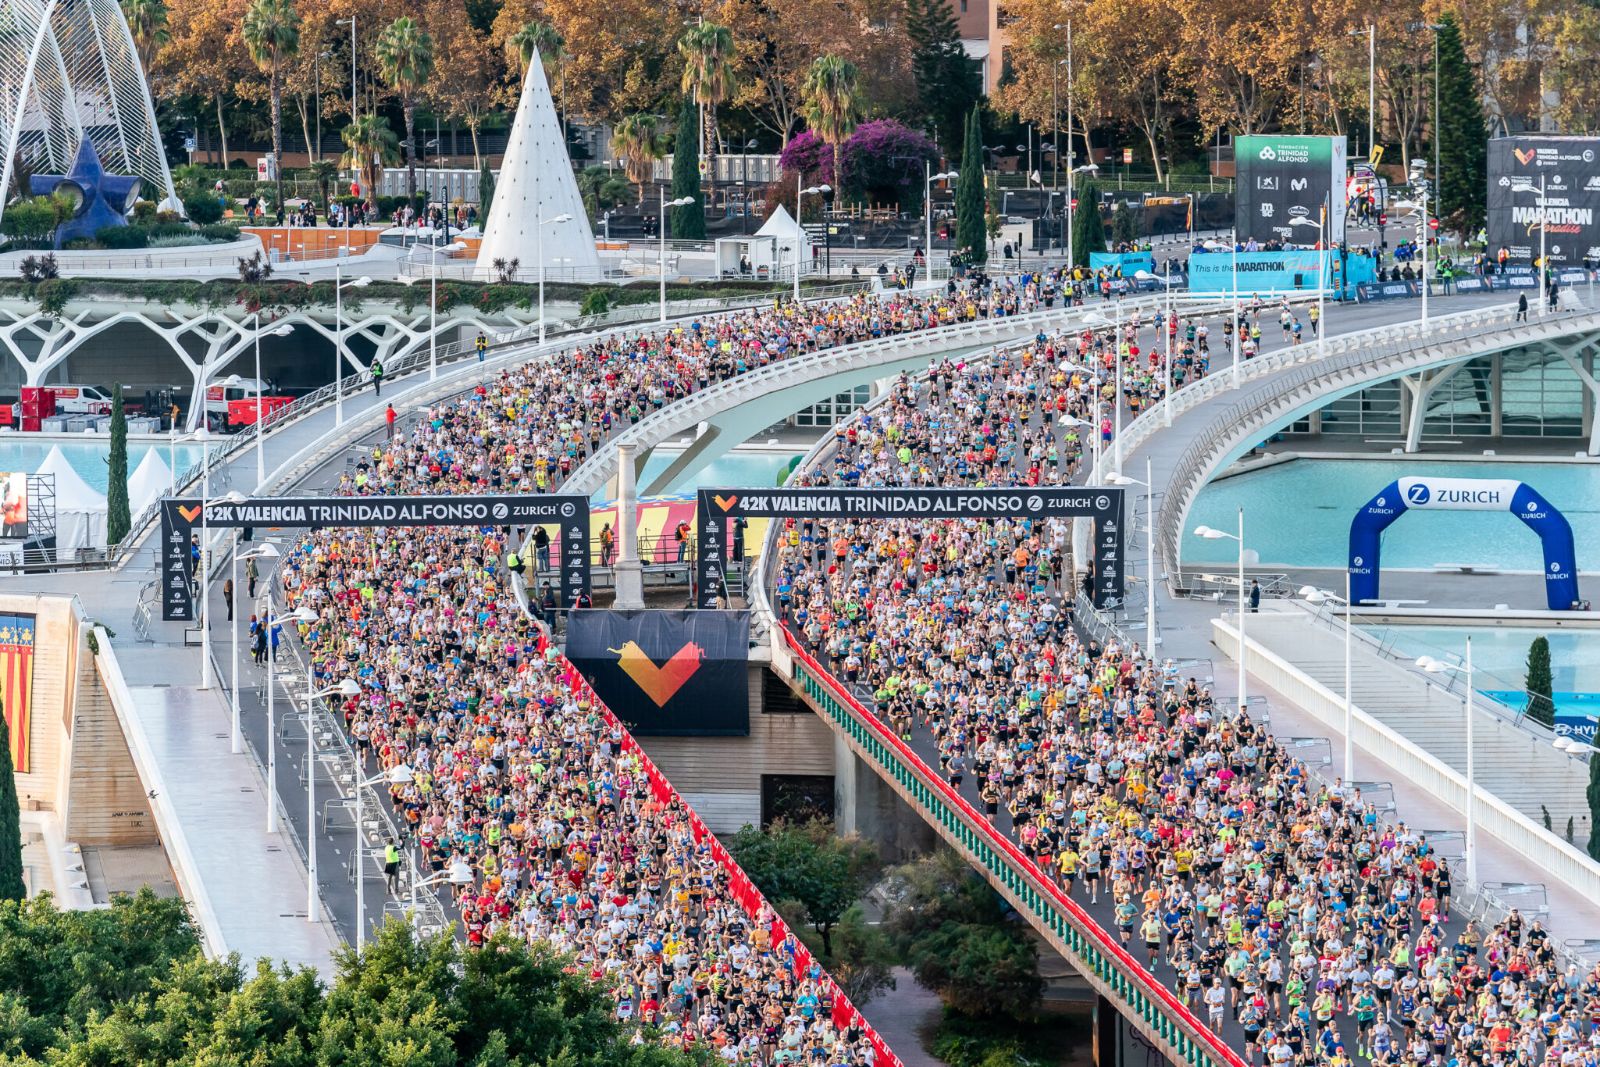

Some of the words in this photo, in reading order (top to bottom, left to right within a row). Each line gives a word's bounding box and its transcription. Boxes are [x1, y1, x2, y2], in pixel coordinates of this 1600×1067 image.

[1512, 206, 1592, 225] MARATHON
[1195, 264, 1211, 272] This
[1212, 264, 1220, 272] is
[1221, 263, 1233, 272] the
[1235, 261, 1285, 272] MARATHON
[738, 496, 769, 511] 42K
[771, 495, 841, 512] VALENCIA
[845, 496, 932, 512] TRINIDAD
[934, 495, 1022, 511] ALFONSO
[1048, 498, 1091, 508] ZURICH
[1437, 490, 1500, 503] ZURICH
[205, 506, 234, 521] 42K
[236, 505, 306, 521] VALENCIA
[310, 504, 397, 521] TRINIDAD
[398, 503, 488, 519] ALFONSO
[513, 505, 556, 516] ZURICH
